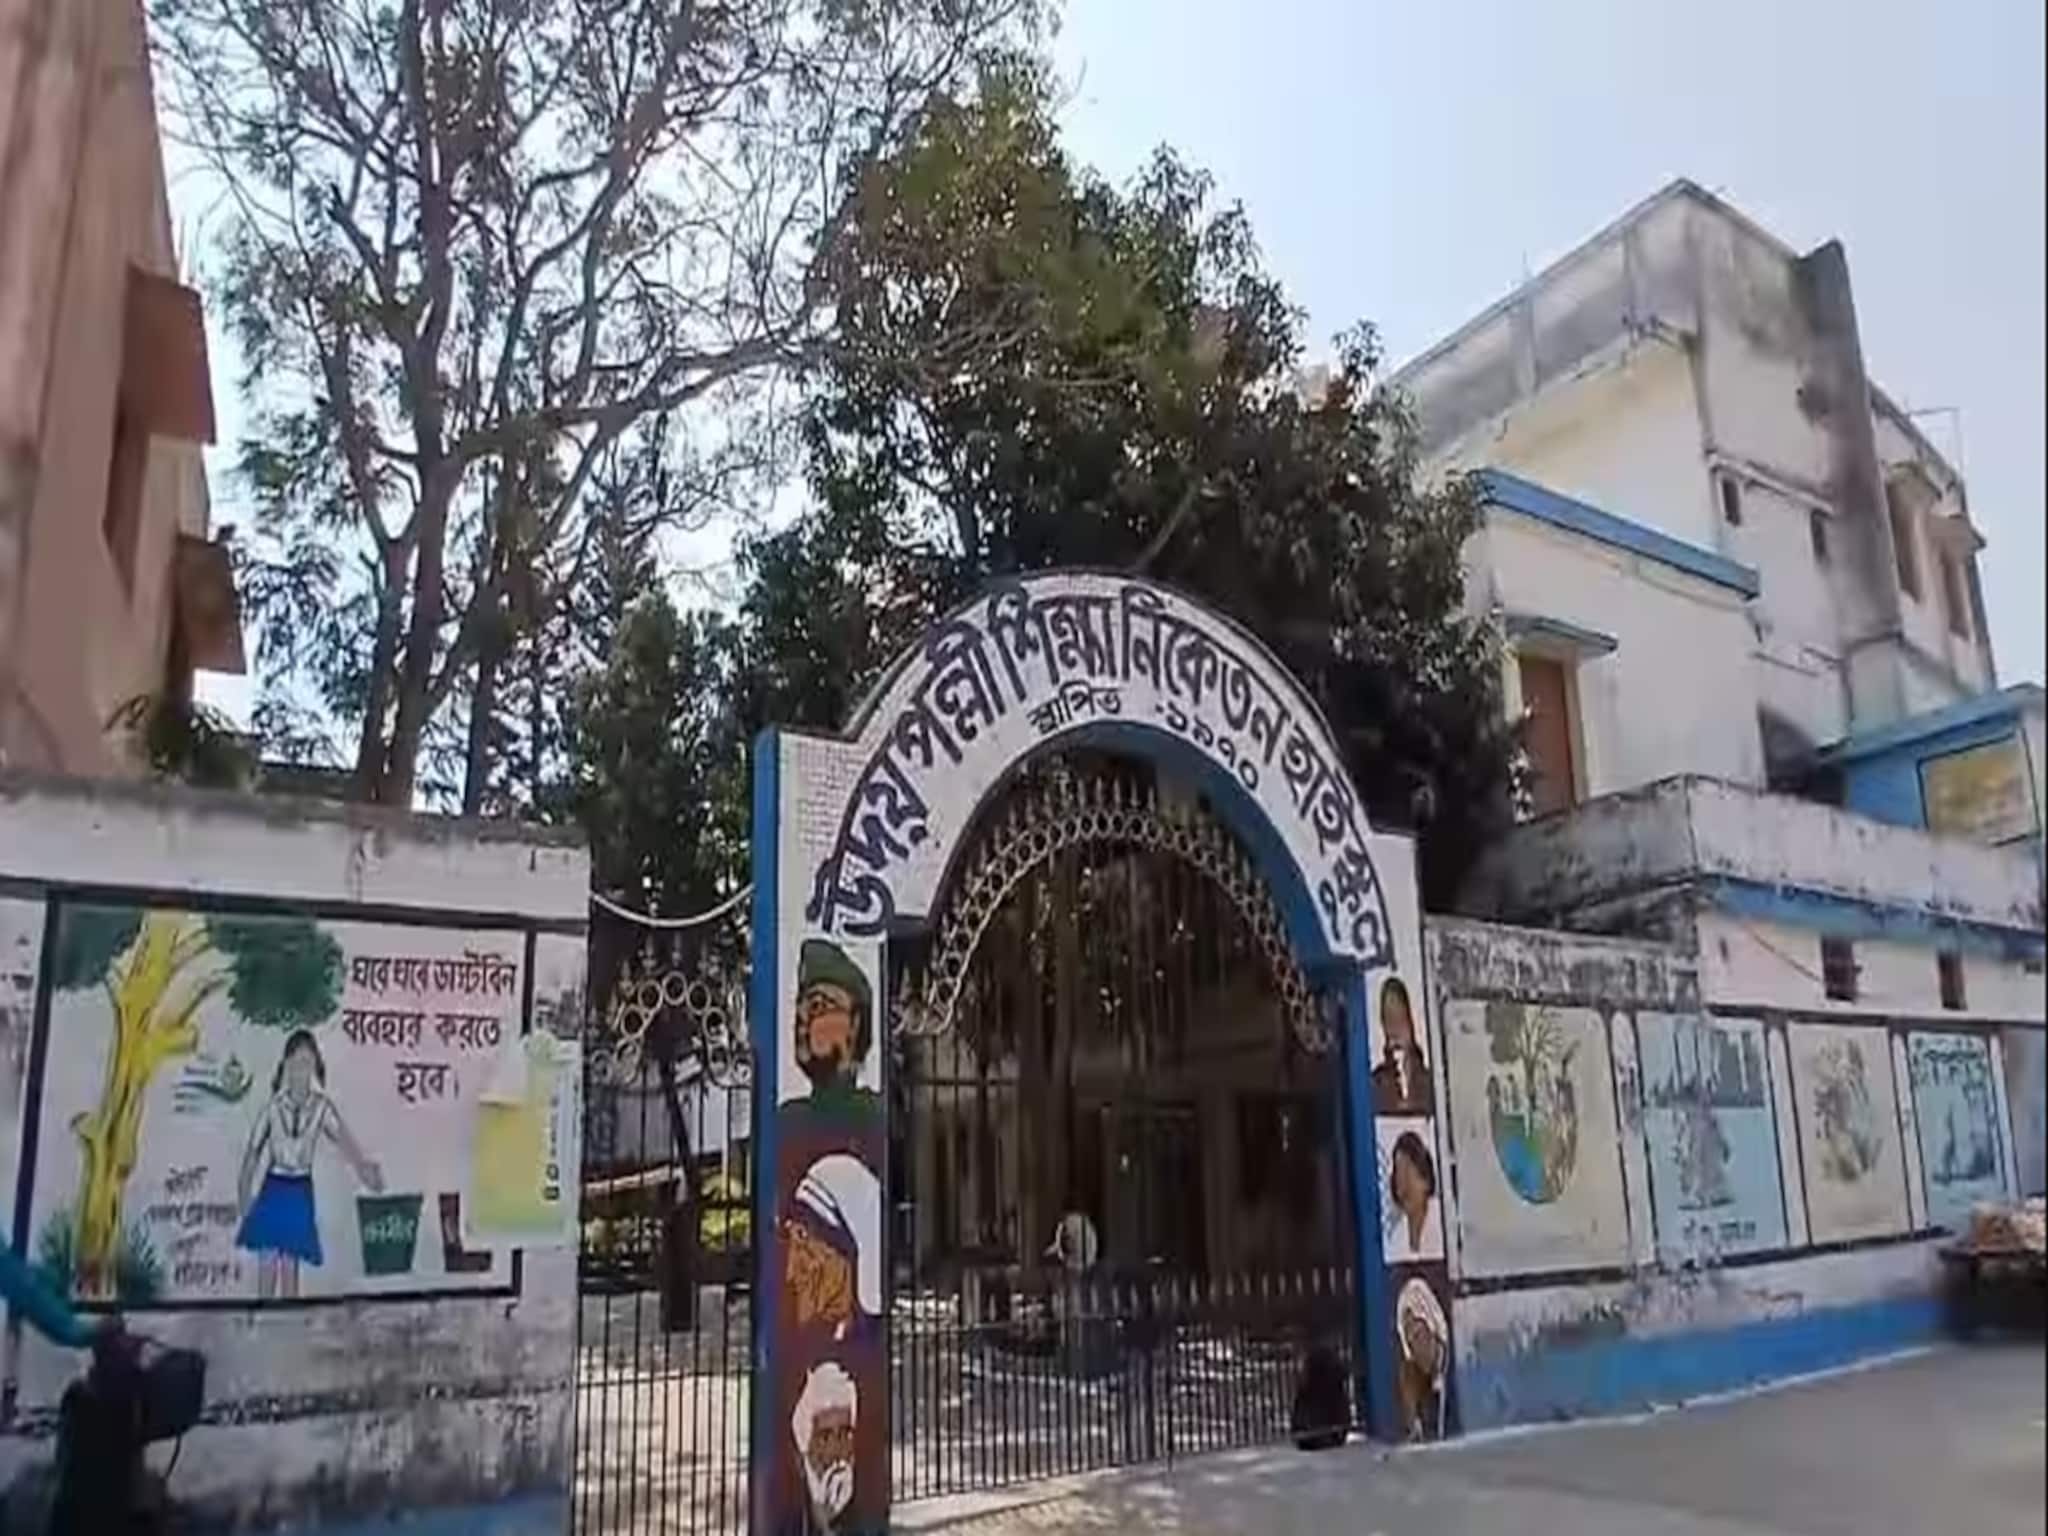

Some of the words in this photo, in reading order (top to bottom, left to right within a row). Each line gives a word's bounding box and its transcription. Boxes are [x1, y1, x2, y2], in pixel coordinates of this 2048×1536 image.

[1027, 678, 1123, 735] স্থাপিত
[353, 956, 388, 996] ঘরে
[392, 957, 430, 997] ঘরে
[433, 948, 518, 996] ডাস্টবিন
[343, 1009, 425, 1049] ব্যবহার
[435, 1012, 501, 1051] করতে
